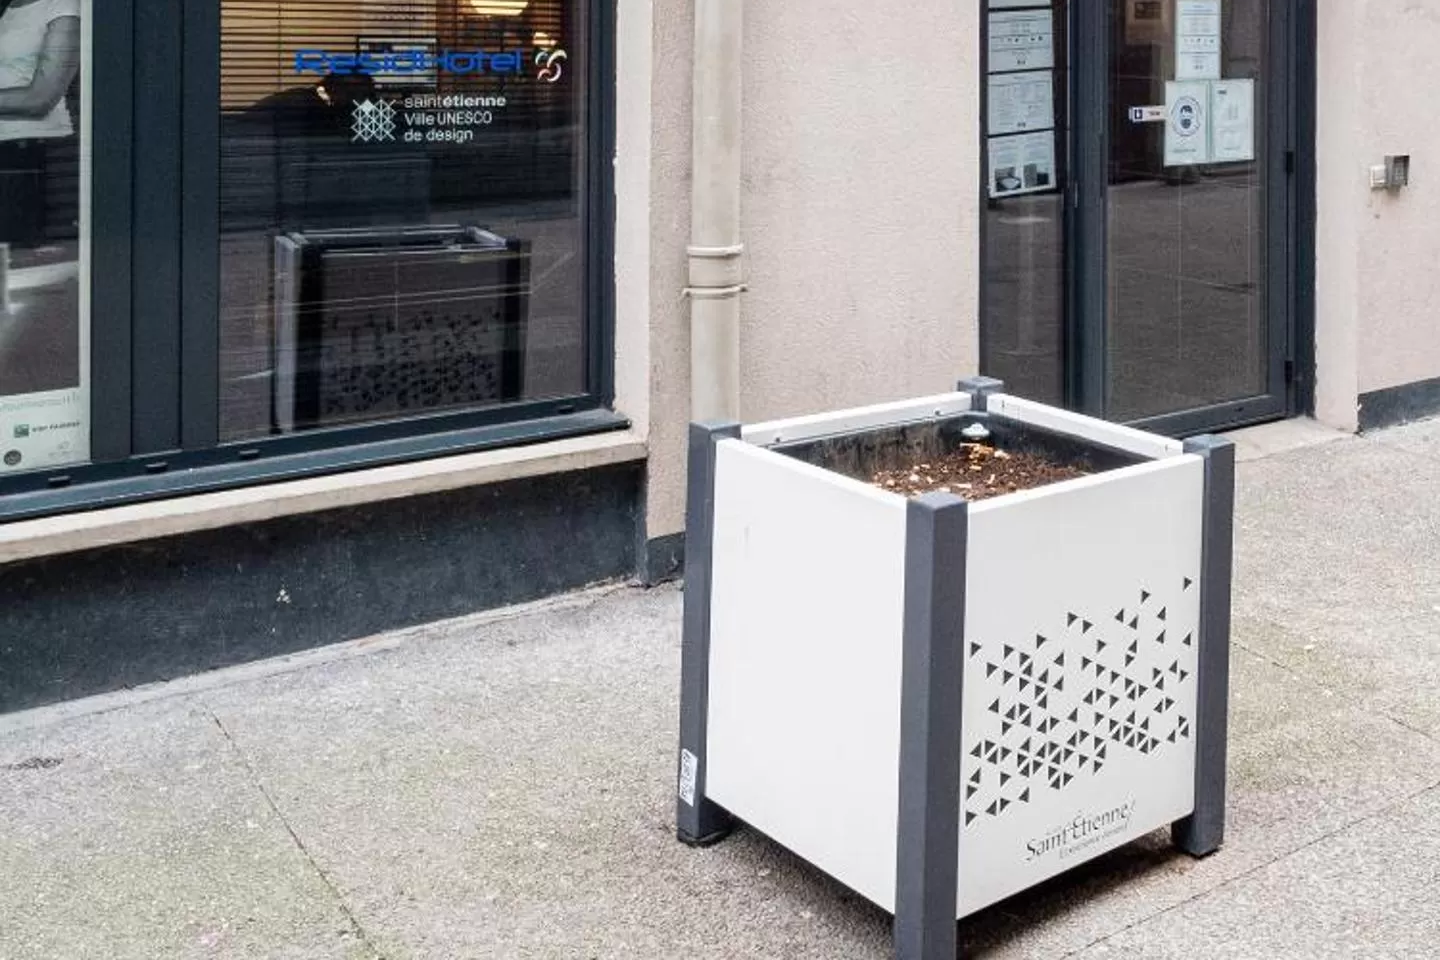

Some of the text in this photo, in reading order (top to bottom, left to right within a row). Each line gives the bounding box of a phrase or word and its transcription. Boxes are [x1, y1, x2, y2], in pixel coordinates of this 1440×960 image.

[294, 49, 522, 75] ResidHotel
[404, 110, 492, 126] Ville UNESCO
[404, 126, 473, 144] de design
